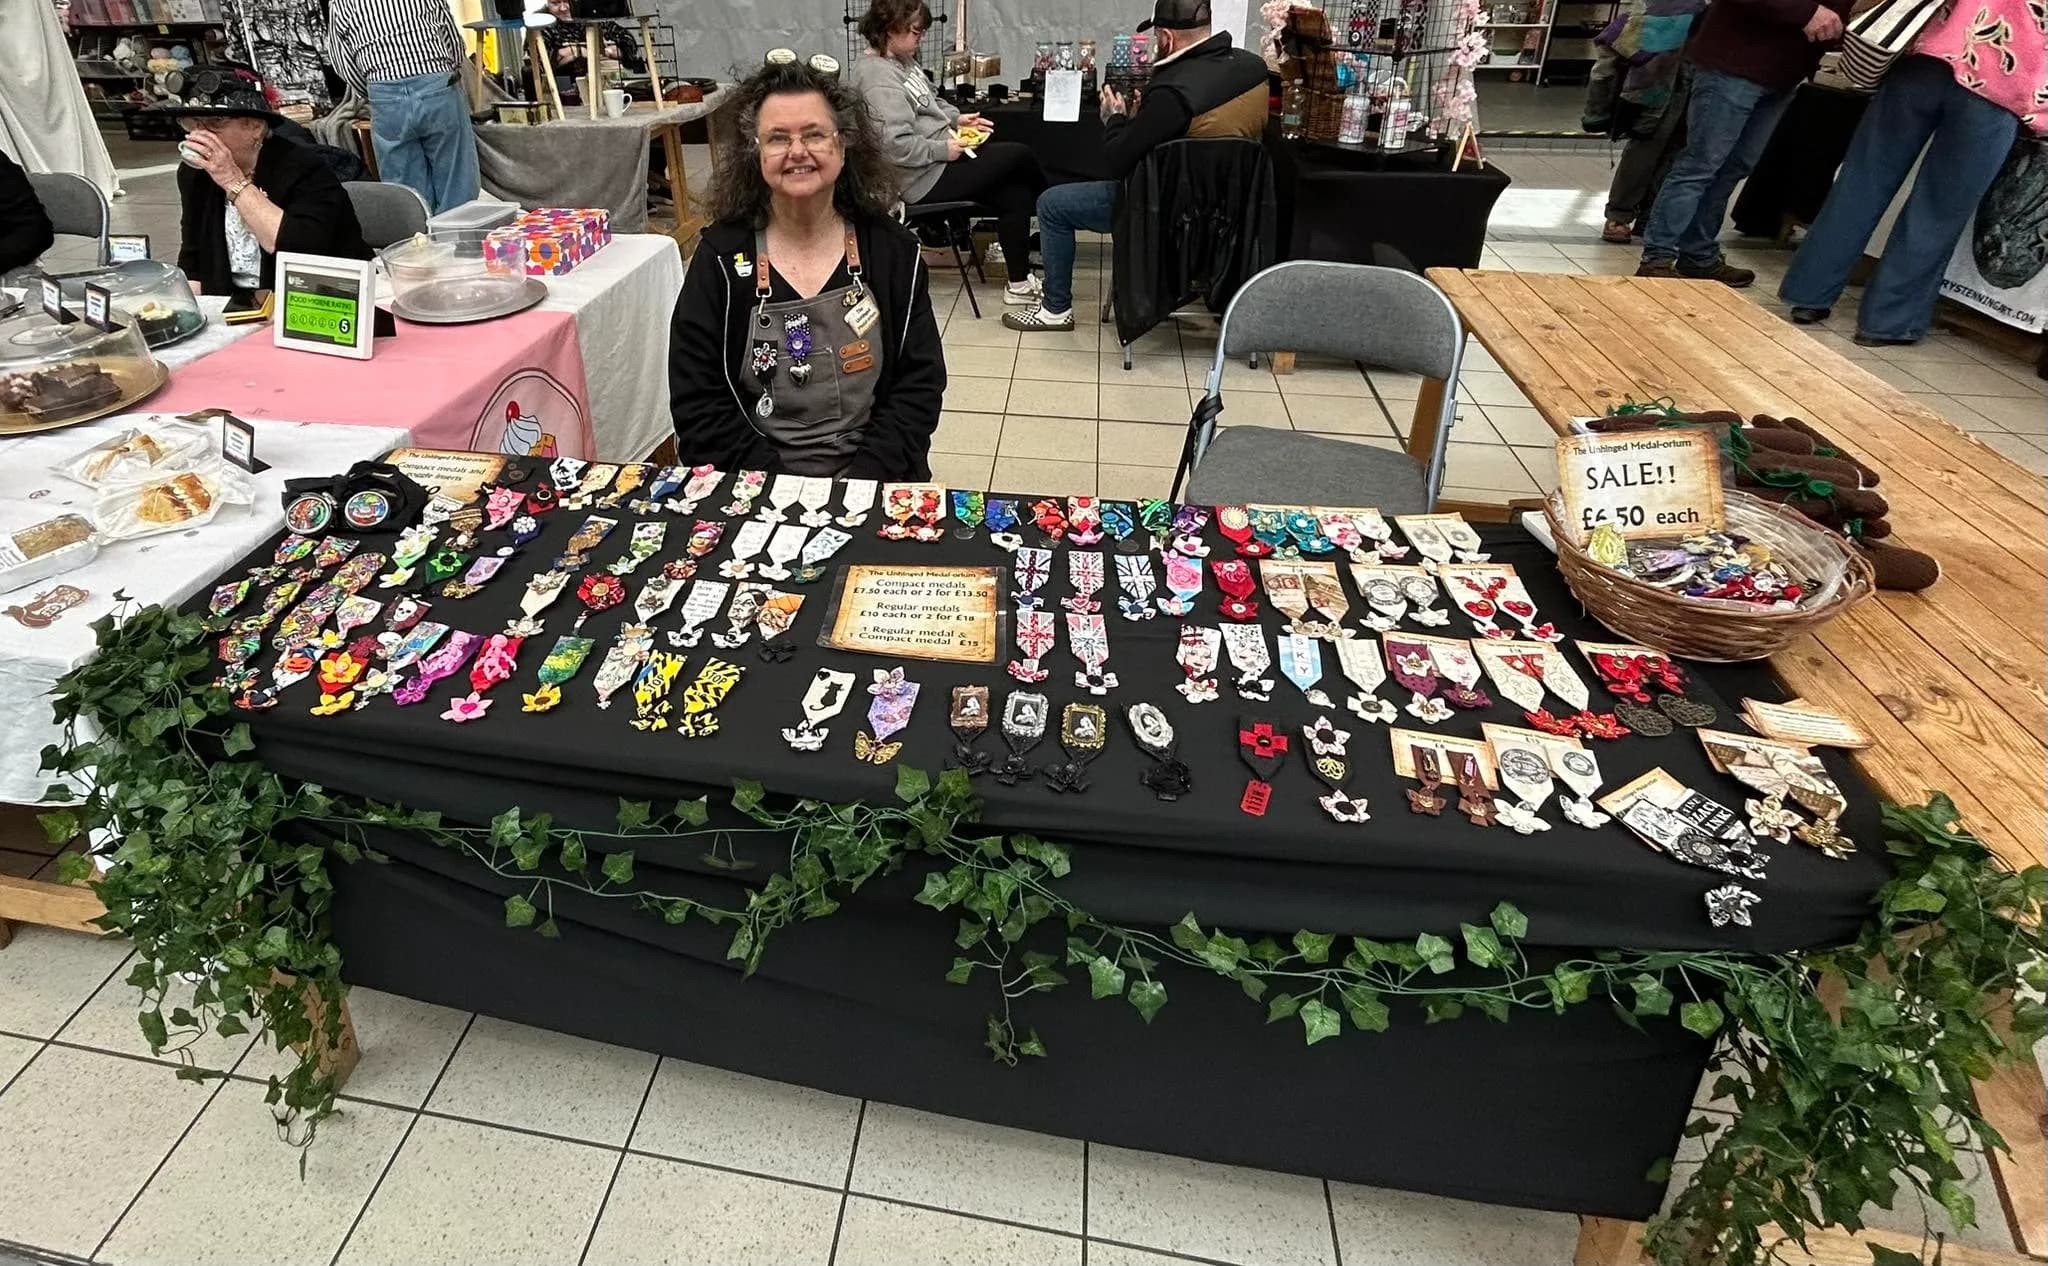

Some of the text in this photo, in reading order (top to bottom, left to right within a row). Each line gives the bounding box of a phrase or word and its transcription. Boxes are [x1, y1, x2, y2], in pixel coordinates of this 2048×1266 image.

[1941, 279, 2037, 325] RYSTENNINGART.COM
[341, 320, 349, 333] 5
[1573, 439, 1692, 456] The Unhinged Medal-orium
[397, 461, 436, 471] Compact
[437, 463, 467, 473] medals
[435, 473, 463, 481] inserts
[1586, 462, 1676, 490] SALE!!
[1582, 505, 1700, 531] £650 each
[869, 569, 884, 577] The
[886, 570, 924, 578] Unhinged
[876, 578, 967, 590] Compact medals
[853, 587, 881, 595] £7.50
[883, 587, 908, 596] each
[935, 589, 951, 597] for
[954, 589, 988, 598] £13.50
[876, 602, 960, 613] Regular medals
[860, 610, 879, 618] £10
[882, 611, 907, 620] each
[936, 612, 953, 621] for
[956, 614, 975, 622] £18
[872, 625, 916, 636] Regular
[919, 627, 955, 638] medal
[858, 632, 912, 643] Compact
[915, 635, 951, 645] medal
[643, 673, 665, 693] STOP
[705, 670, 728, 684] STOP
[1705, 810, 1732, 831] INK
